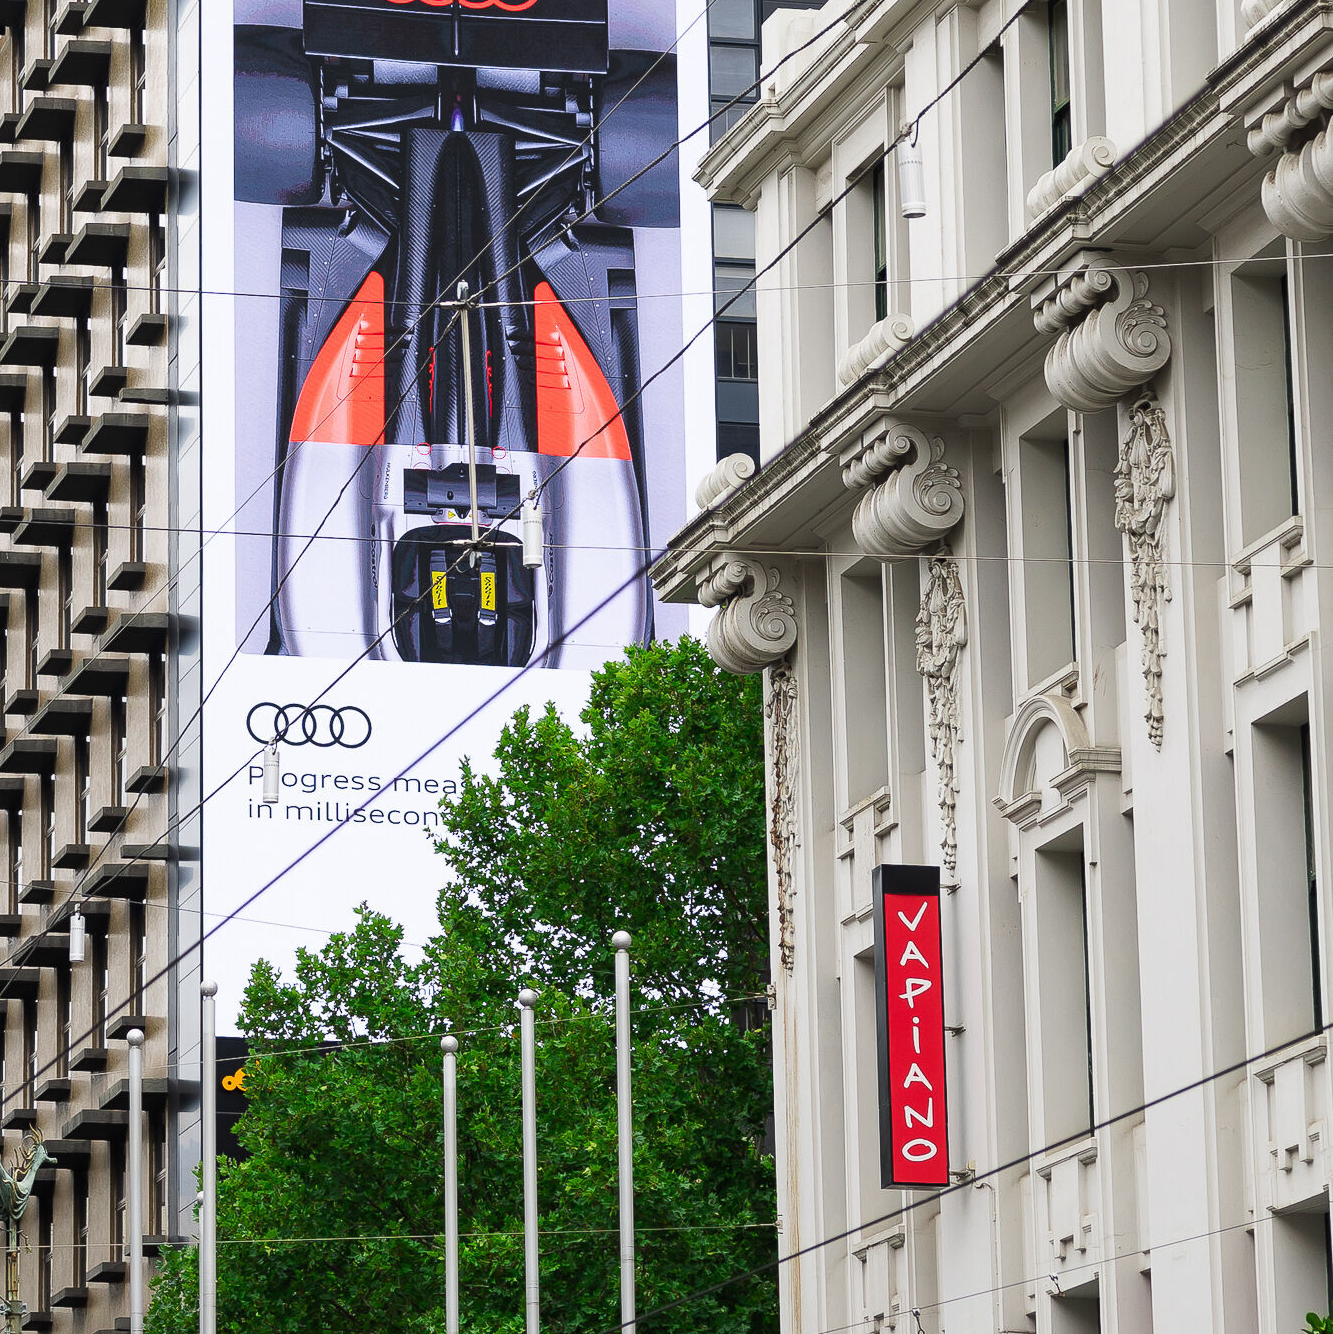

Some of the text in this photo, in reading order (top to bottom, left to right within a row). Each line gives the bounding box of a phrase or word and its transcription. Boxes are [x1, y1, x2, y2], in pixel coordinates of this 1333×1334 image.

[249, 765, 381, 794] Pogress
[249, 798, 439, 827] in millisecon
